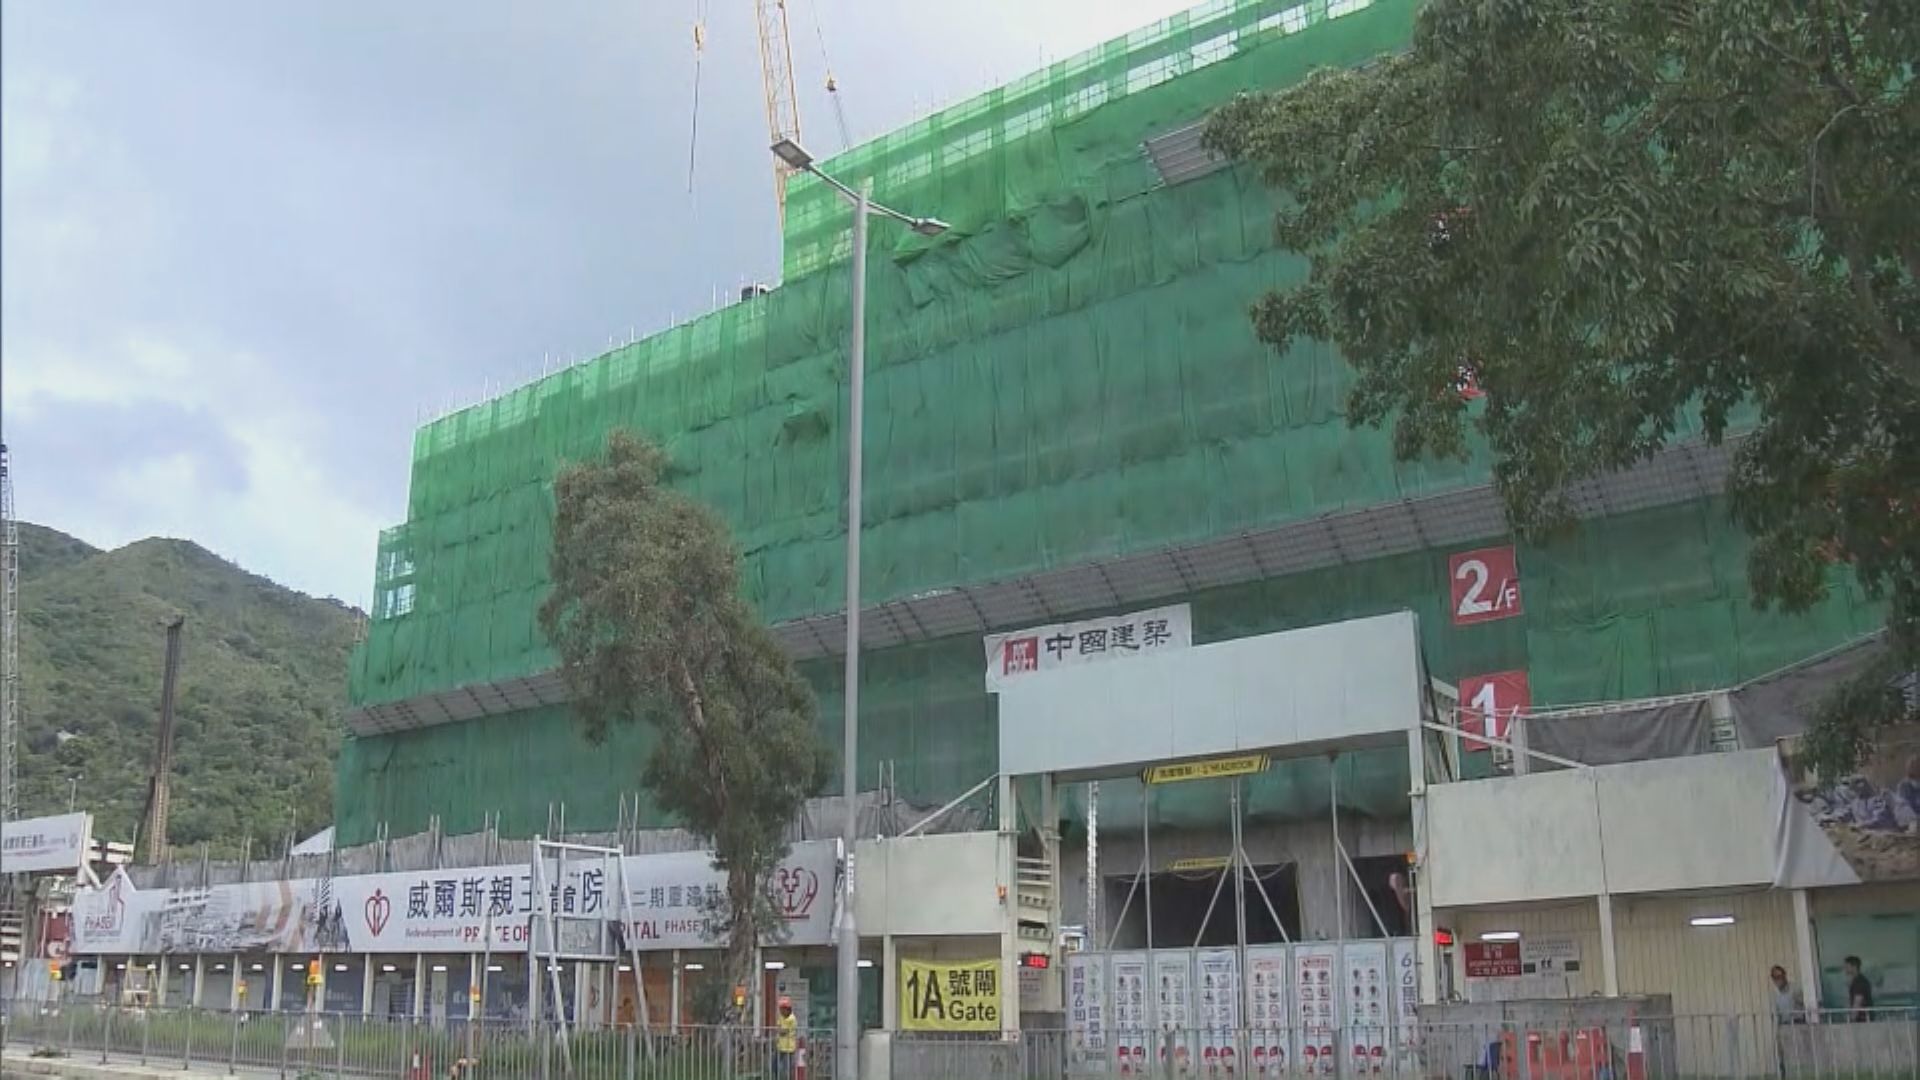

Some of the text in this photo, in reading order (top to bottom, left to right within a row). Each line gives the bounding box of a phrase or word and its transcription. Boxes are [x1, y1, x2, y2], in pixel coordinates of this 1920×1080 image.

[1456, 559, 1516, 616] 2/F
[1045, 619, 1172, 661] 中國建築
[906, 968, 945, 1020] 1A
[949, 969, 996, 997] 號閘
[949, 1000, 996, 1022] Gate
